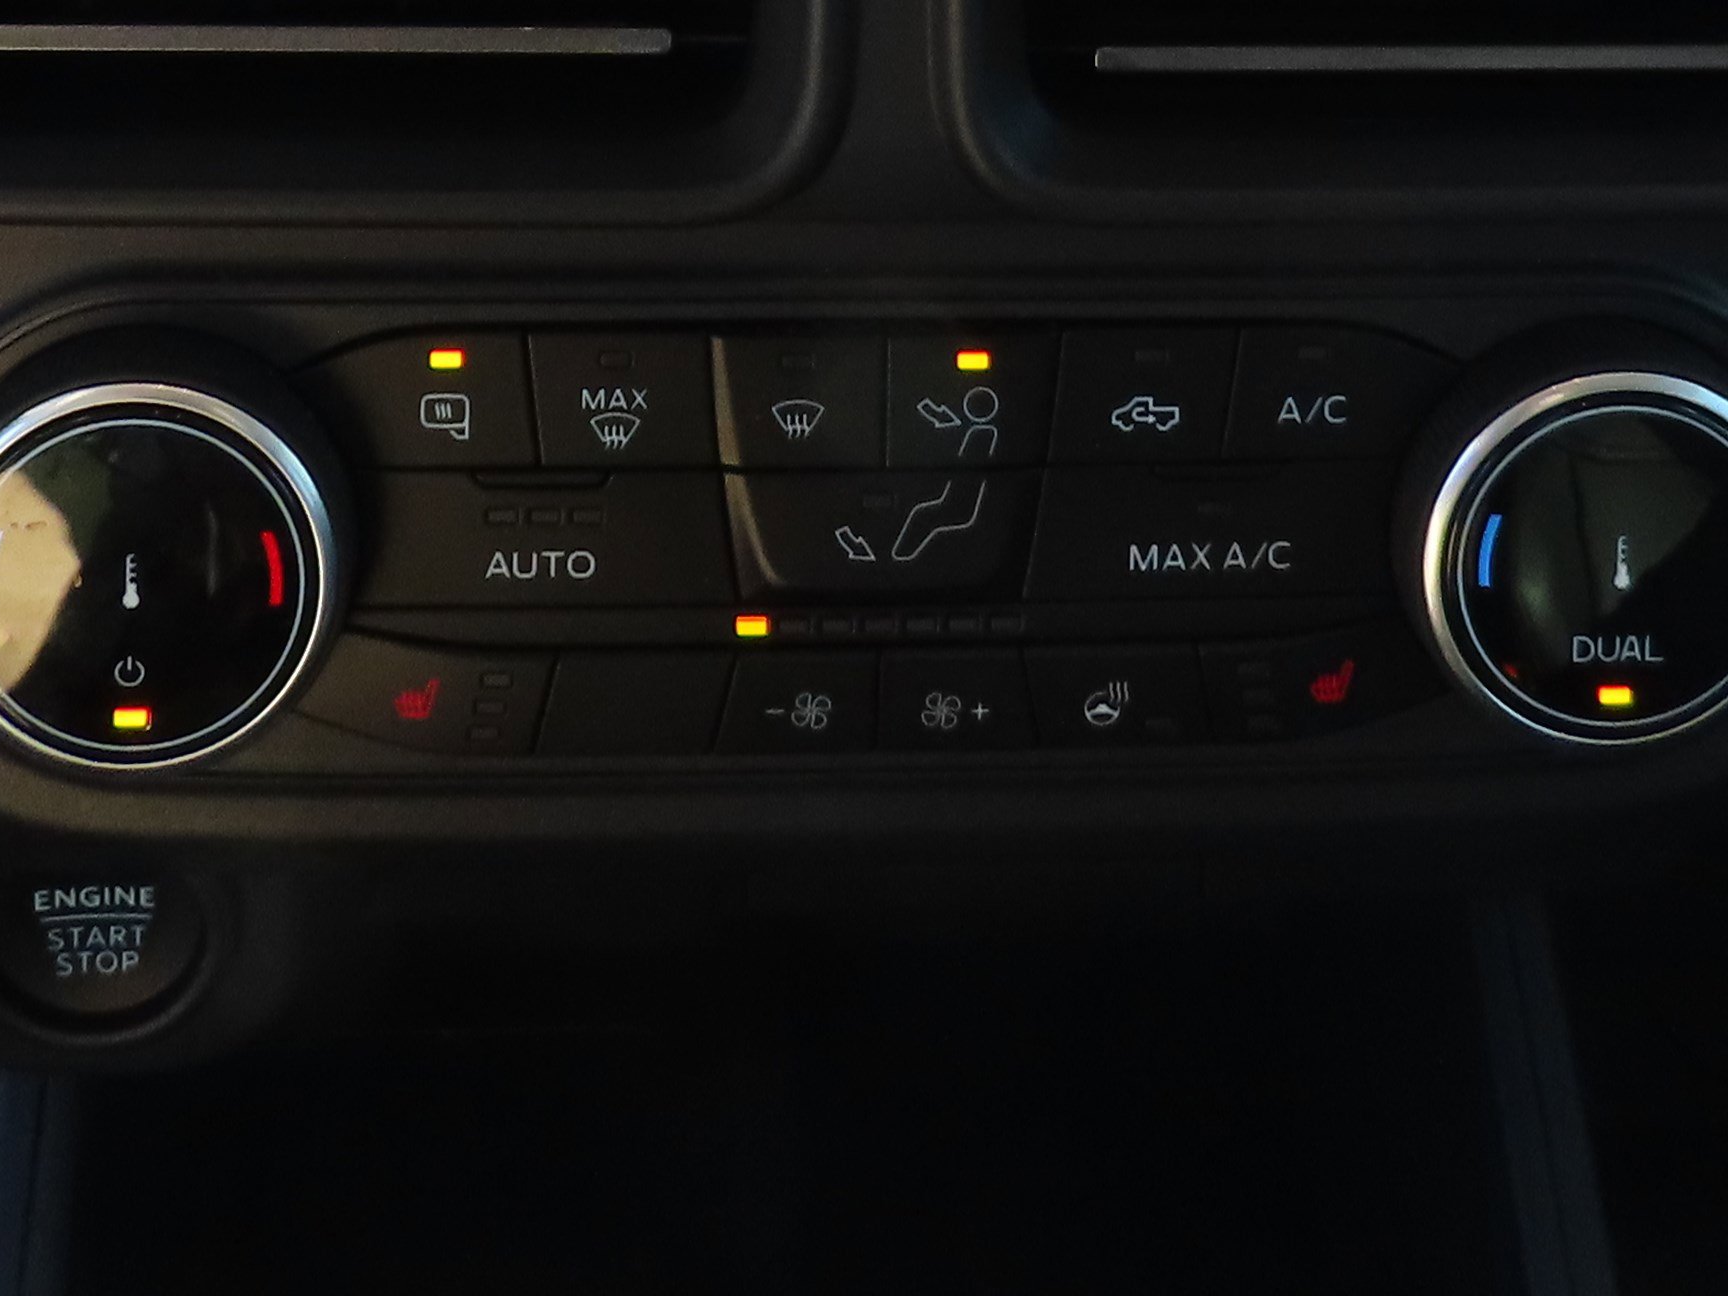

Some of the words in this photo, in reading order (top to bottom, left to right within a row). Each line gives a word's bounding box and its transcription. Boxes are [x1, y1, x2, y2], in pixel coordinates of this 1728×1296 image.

[581, 388, 647, 411] MAX
[1277, 396, 1347, 424] A/C
[485, 551, 596, 579] AUTO
[1129, 543, 1211, 571] MAX
[1223, 542, 1291, 569] A/C
[1572, 635, 1662, 663] DUAL
[34, 886, 154, 912] ENGINE
[48, 926, 144, 951] START
[56, 950, 140, 976] STOP
